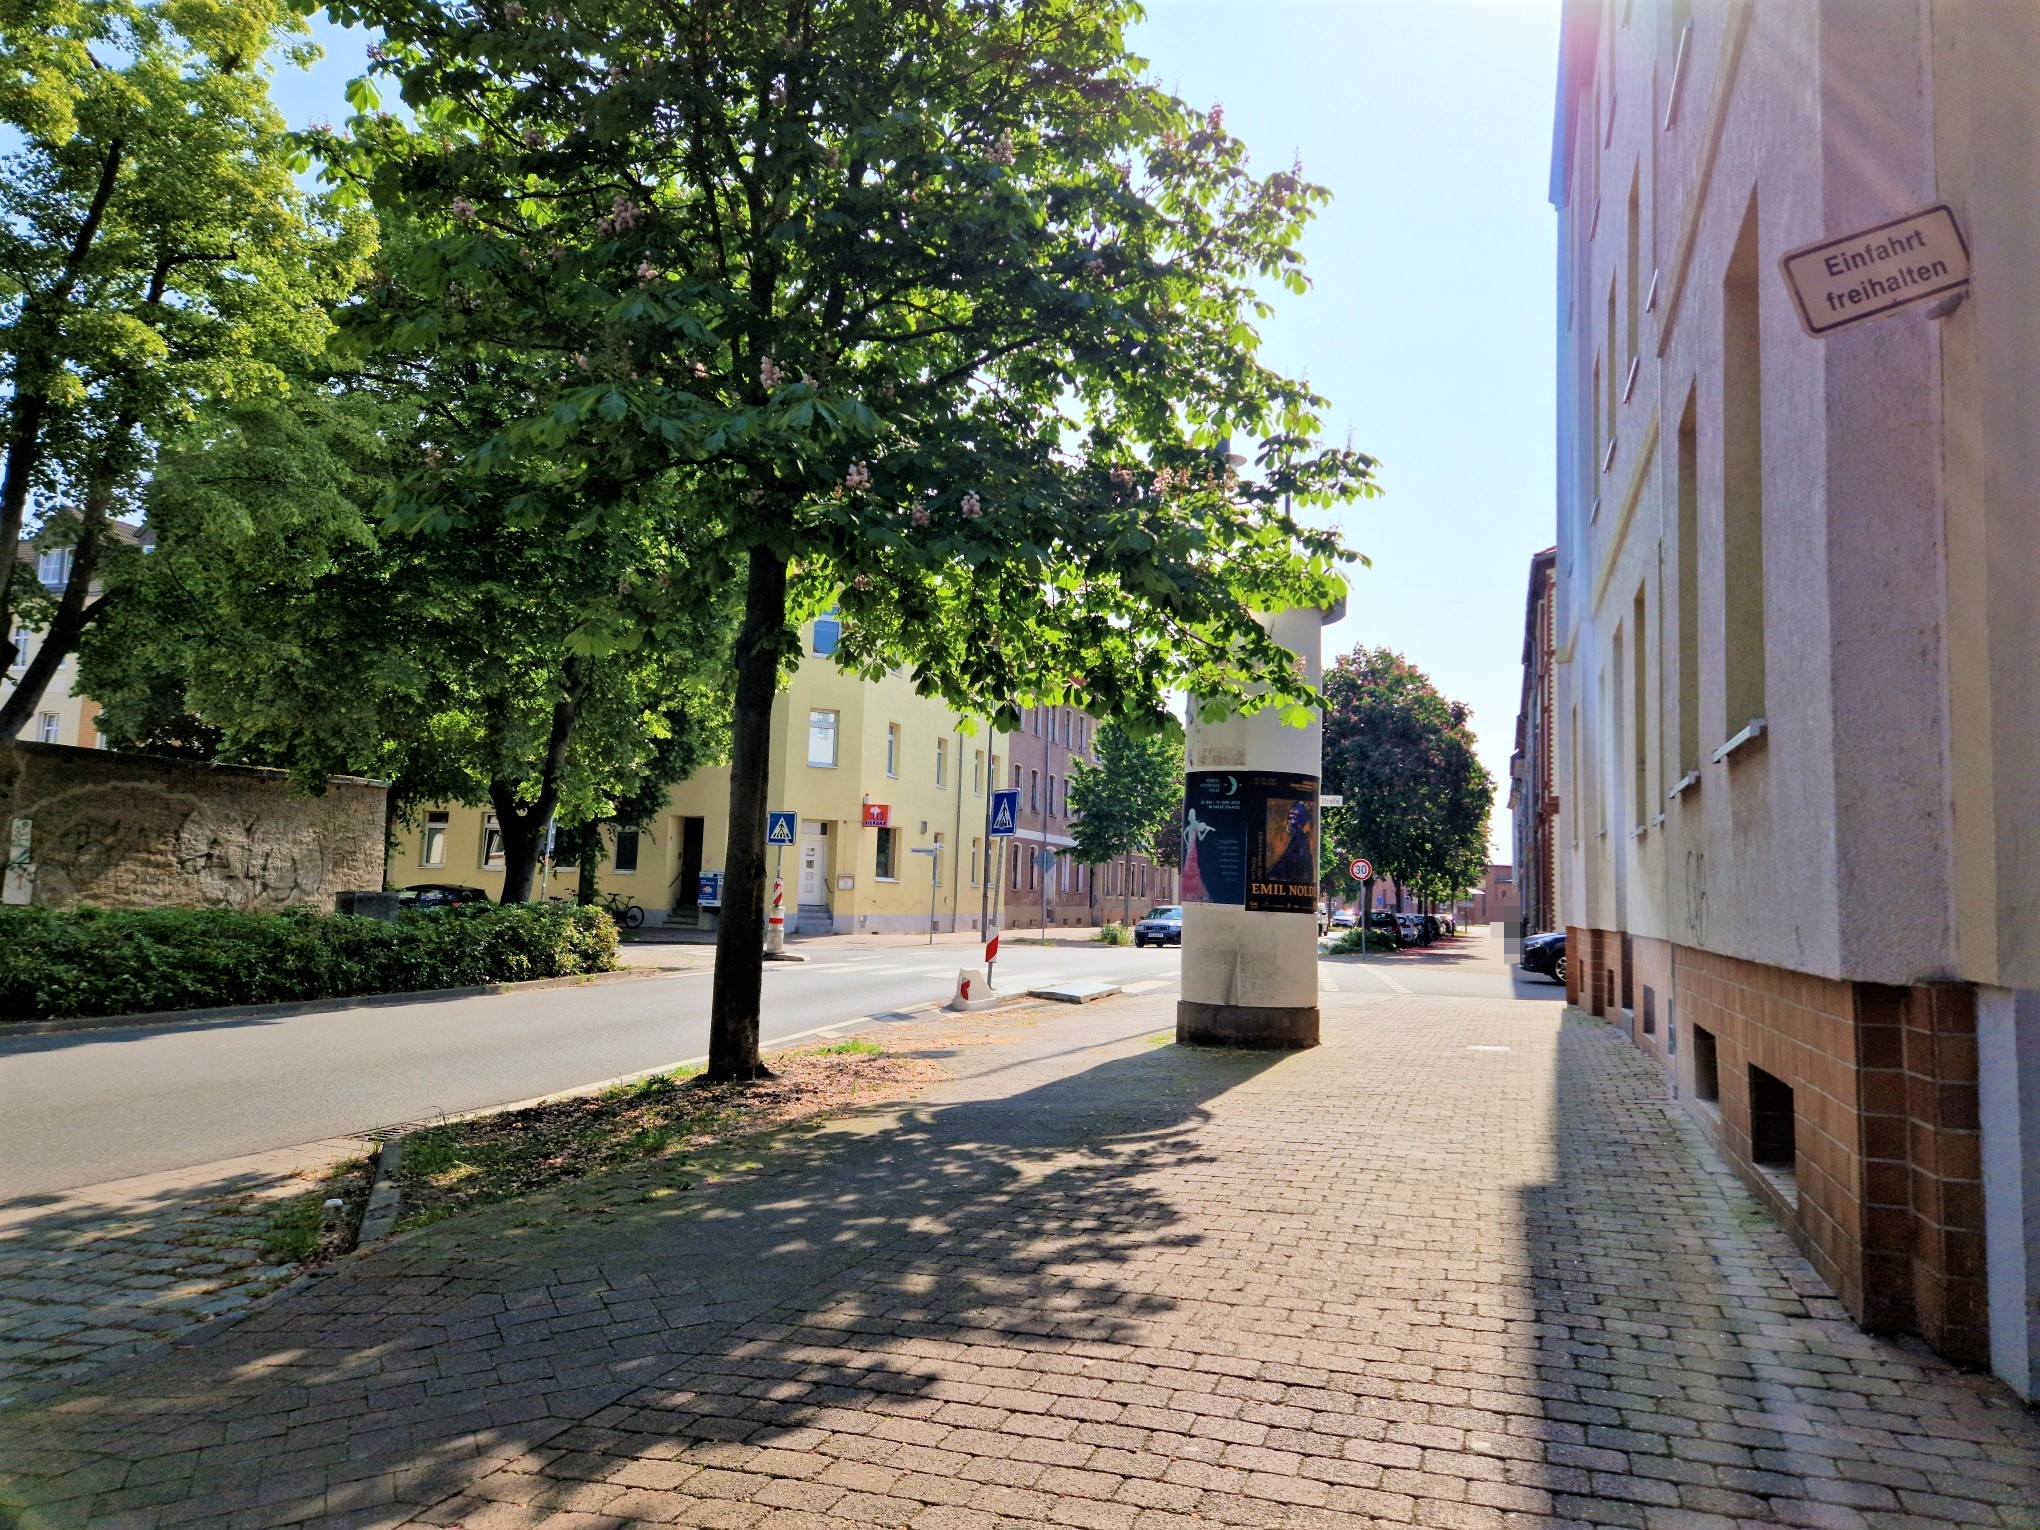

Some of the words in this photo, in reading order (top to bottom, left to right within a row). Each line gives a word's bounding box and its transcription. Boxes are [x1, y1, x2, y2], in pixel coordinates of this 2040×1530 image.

[1824, 229, 1926, 277] Einfahrt
[1826, 260, 1948, 312] freihalten
[1320, 797, 1340, 805] Straße
[1355, 864, 1367, 875] 30
[1251, 883, 1286, 896] EMIL
